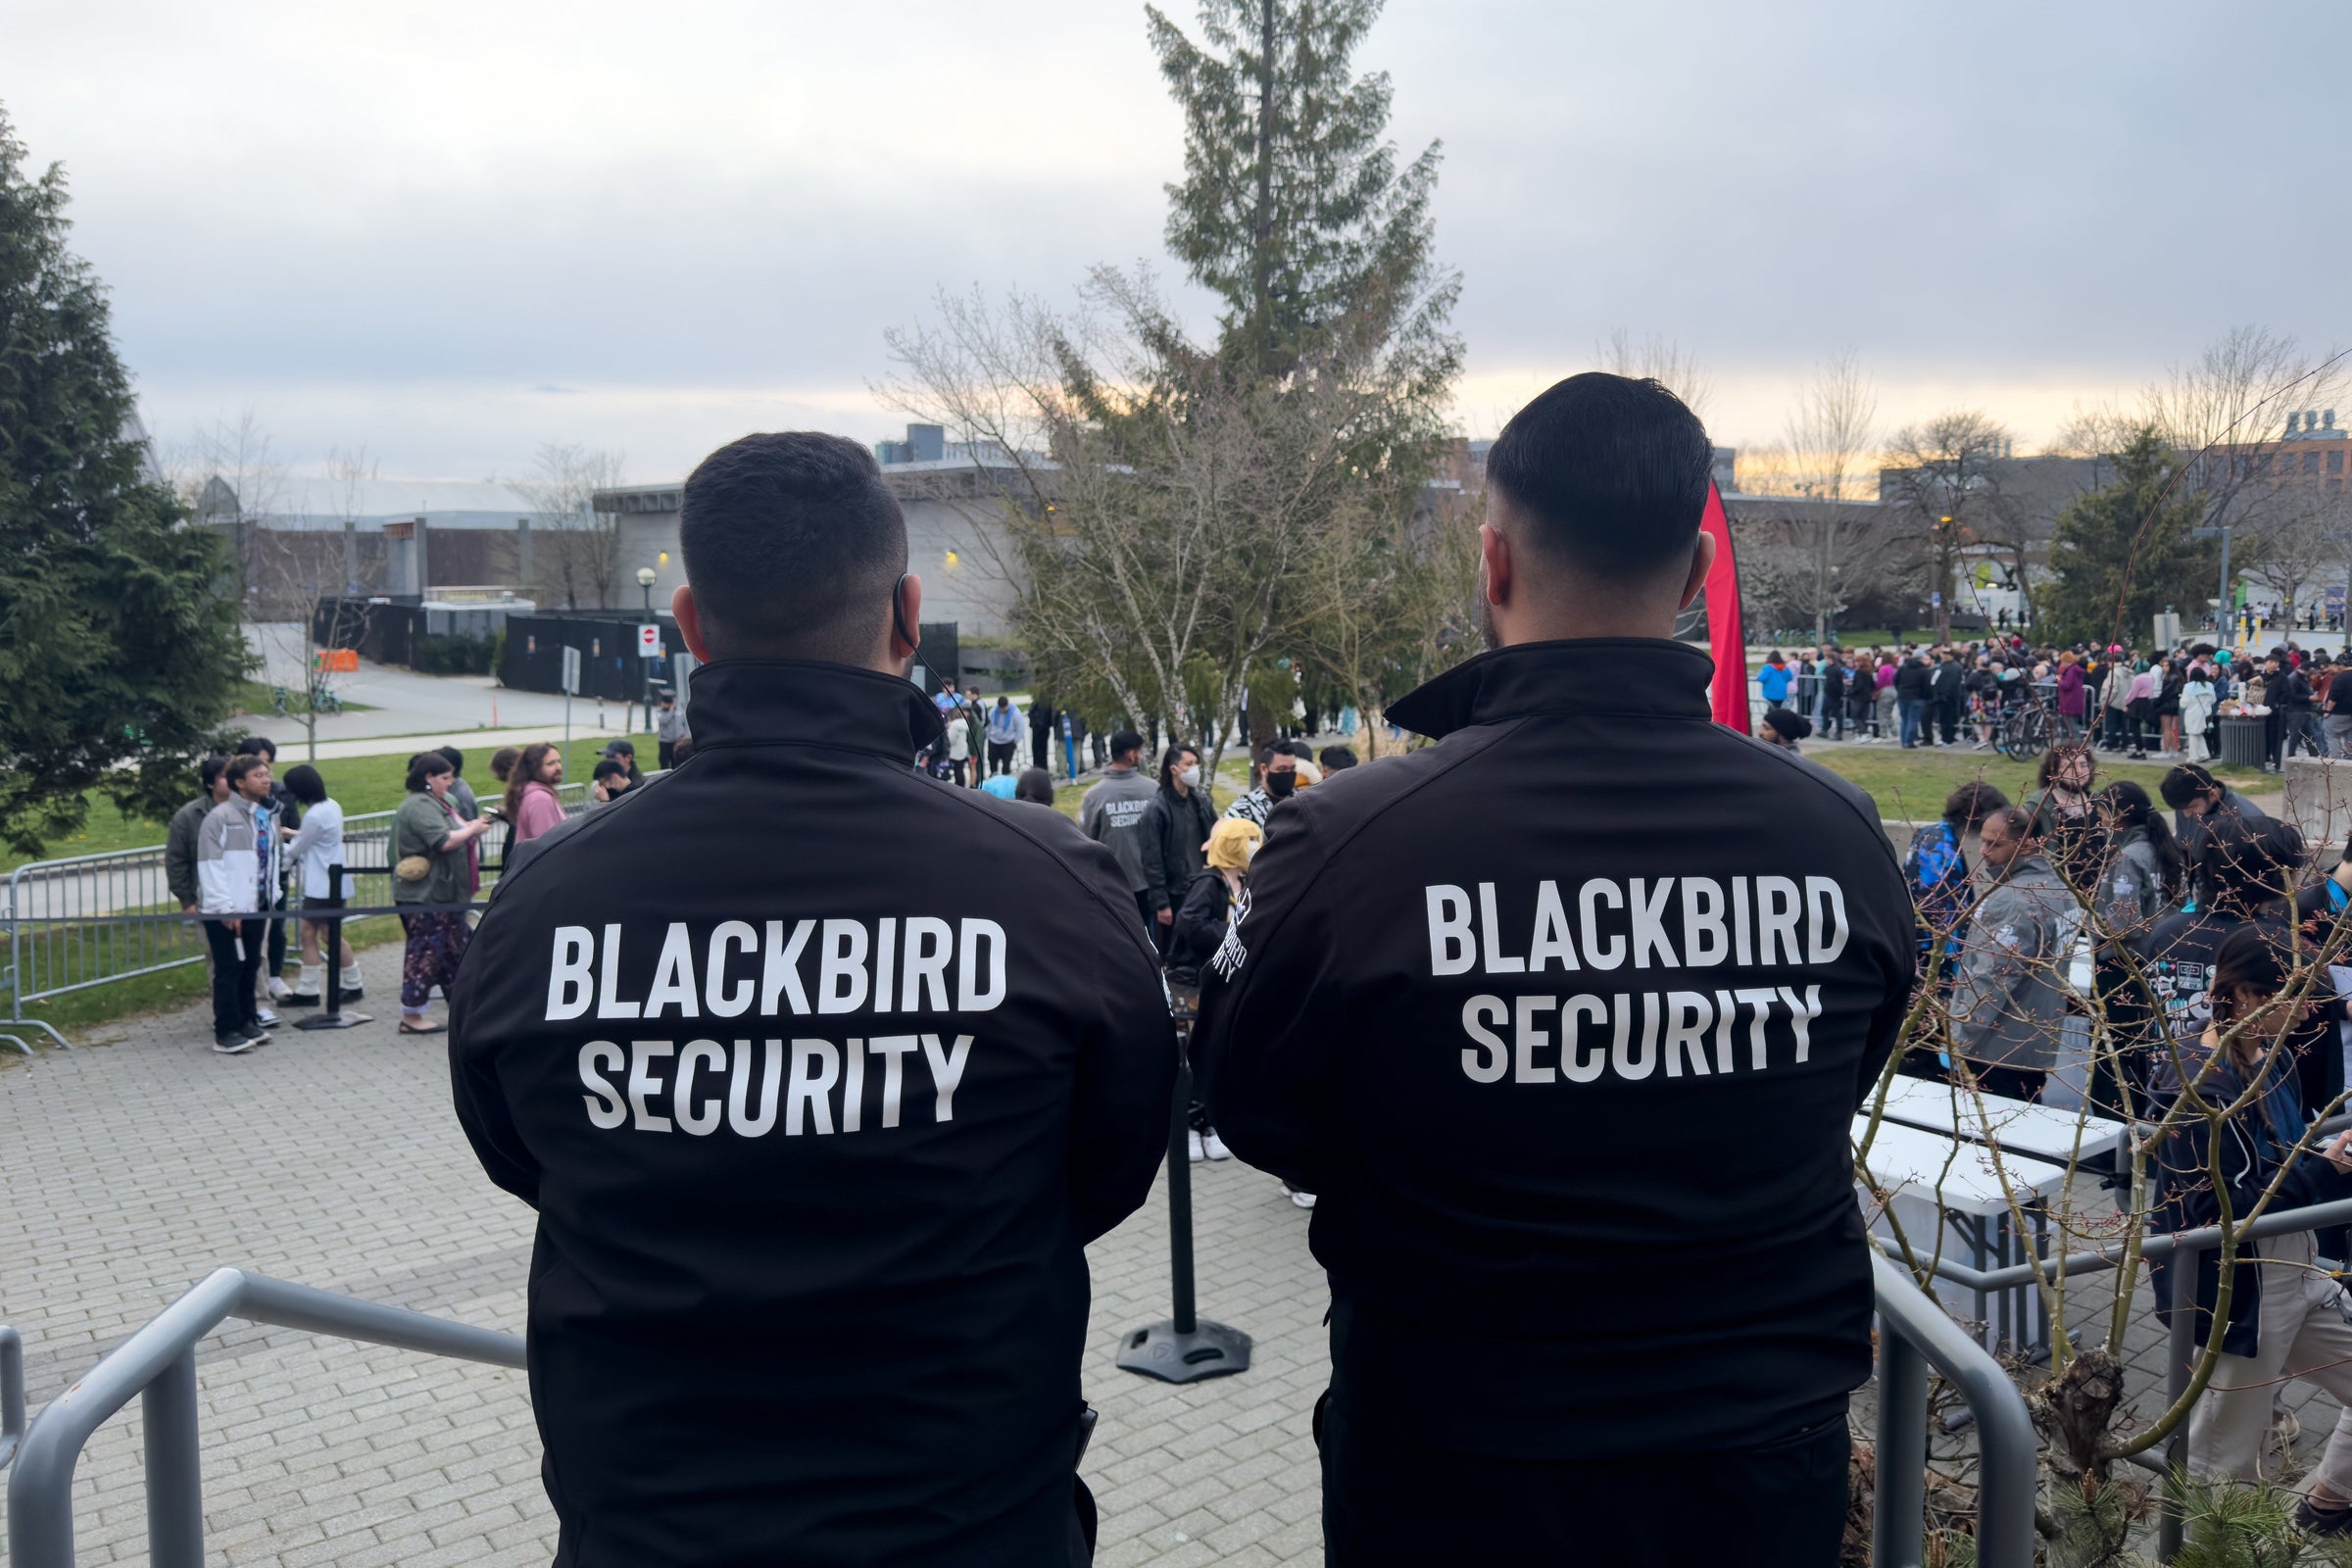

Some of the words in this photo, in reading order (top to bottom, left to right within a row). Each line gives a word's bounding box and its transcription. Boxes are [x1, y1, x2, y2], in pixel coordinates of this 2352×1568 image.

[544, 916, 1007, 1021] BLACKBIRD
[1425, 875, 1850, 977] BLACKBIRD
[1461, 984, 1823, 1084] SECURITY
[577, 1033, 975, 1139] SECURITY
